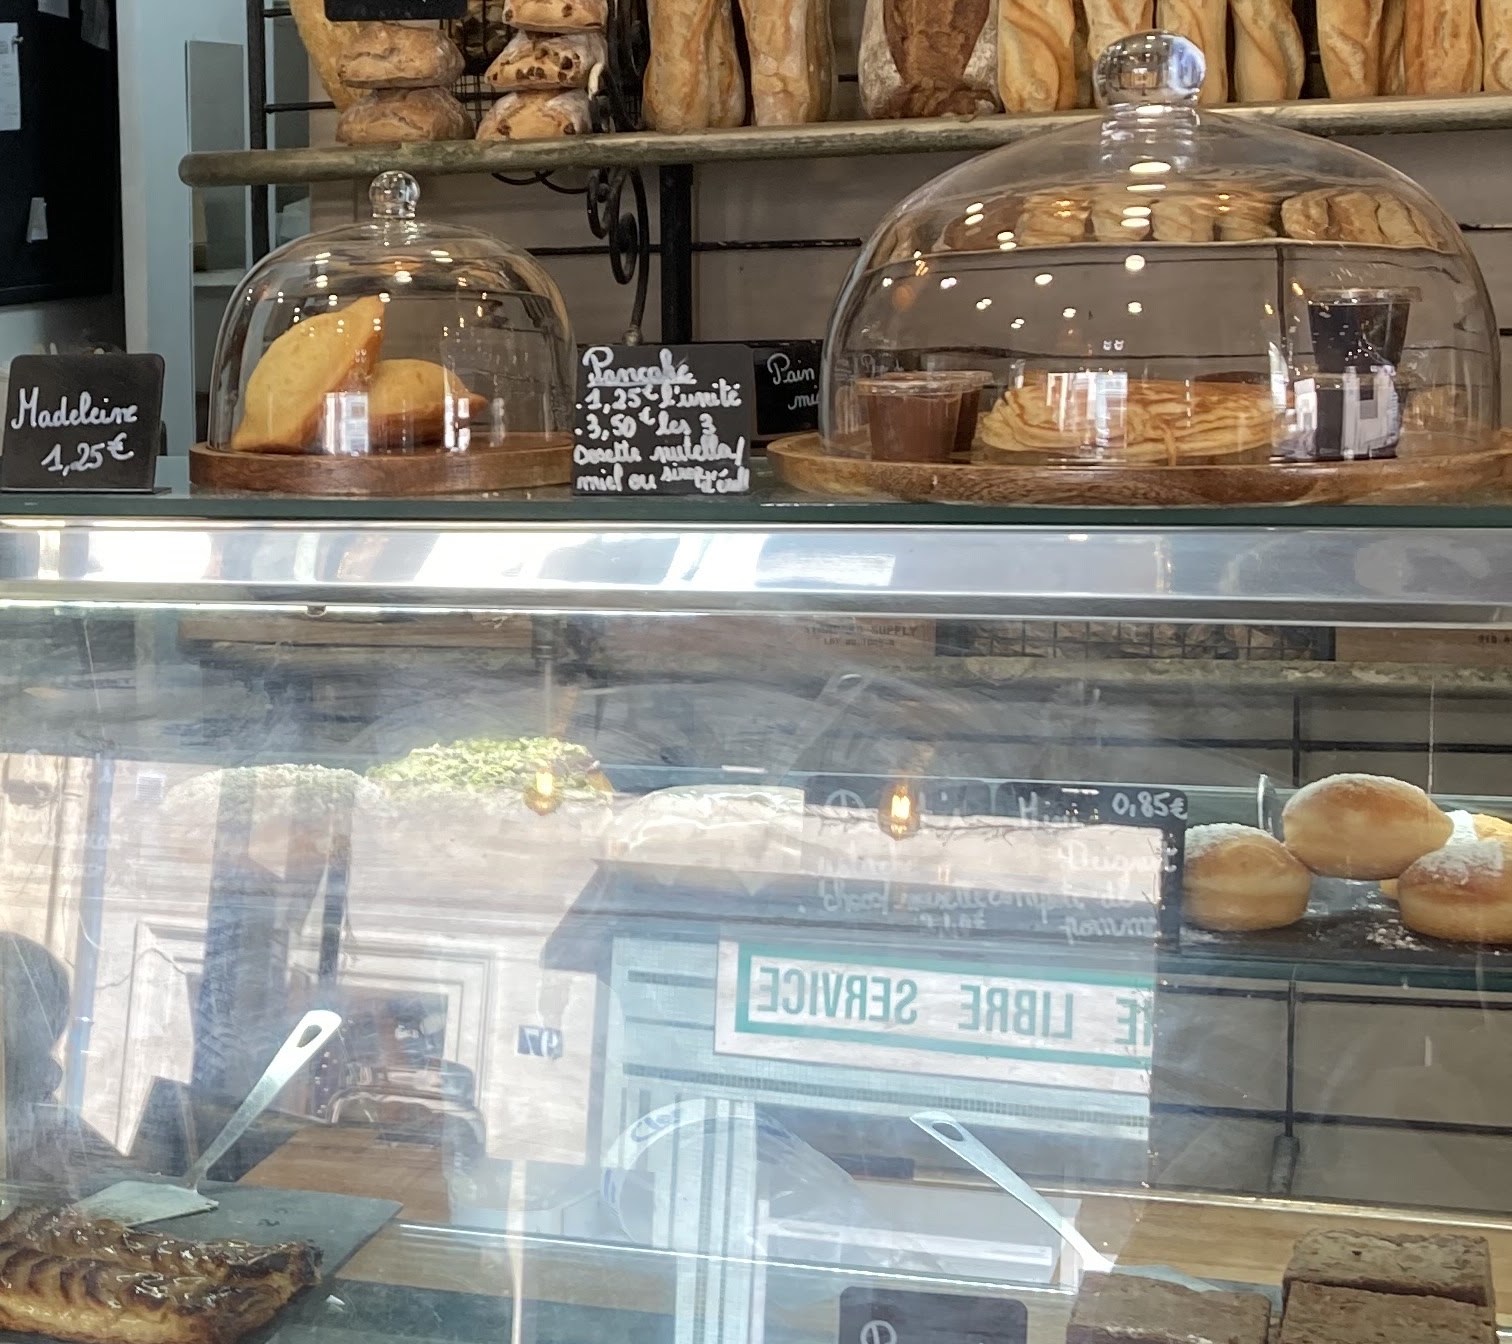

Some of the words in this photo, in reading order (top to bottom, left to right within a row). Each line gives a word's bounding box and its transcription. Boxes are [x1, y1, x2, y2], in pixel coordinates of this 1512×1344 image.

[767, 353, 815, 385] Pain
[10, 387, 138, 430] Madeleine
[40, 432, 135, 476] 1,25€
[576, 463, 623, 492] miel
[628, 473, 657, 490] ou
[1111, 791, 1188, 821] 0,85€
